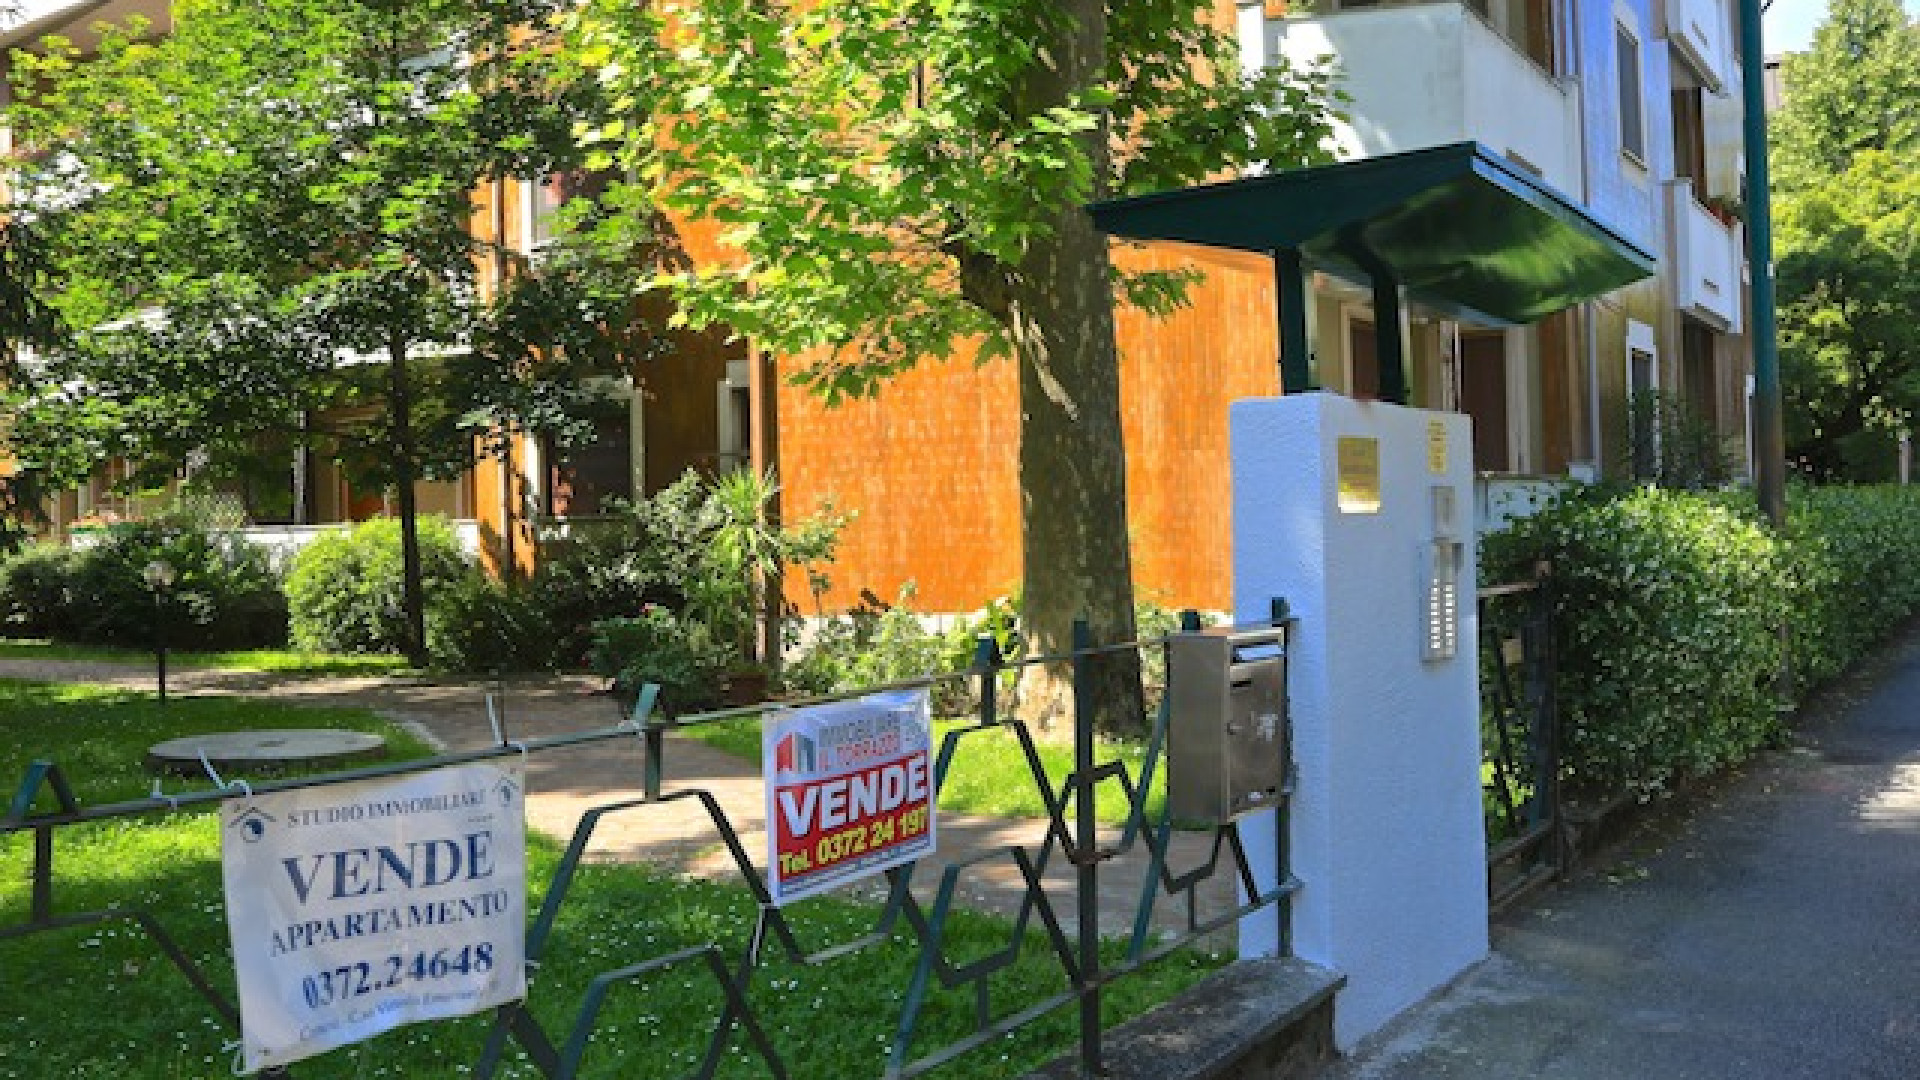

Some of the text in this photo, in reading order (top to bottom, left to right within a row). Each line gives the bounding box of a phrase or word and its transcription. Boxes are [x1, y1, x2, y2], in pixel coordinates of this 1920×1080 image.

[287, 802, 364, 828] STUDIO
[779, 755, 928, 838] VENDE
[281, 829, 496, 906] VENDE
[779, 848, 812, 875] Tel.
[816, 825, 868, 864] 0372
[869, 817, 896, 847] 24
[269, 887, 509, 957] APPARTAMENTO
[301, 941, 494, 1010] 0372.24648
